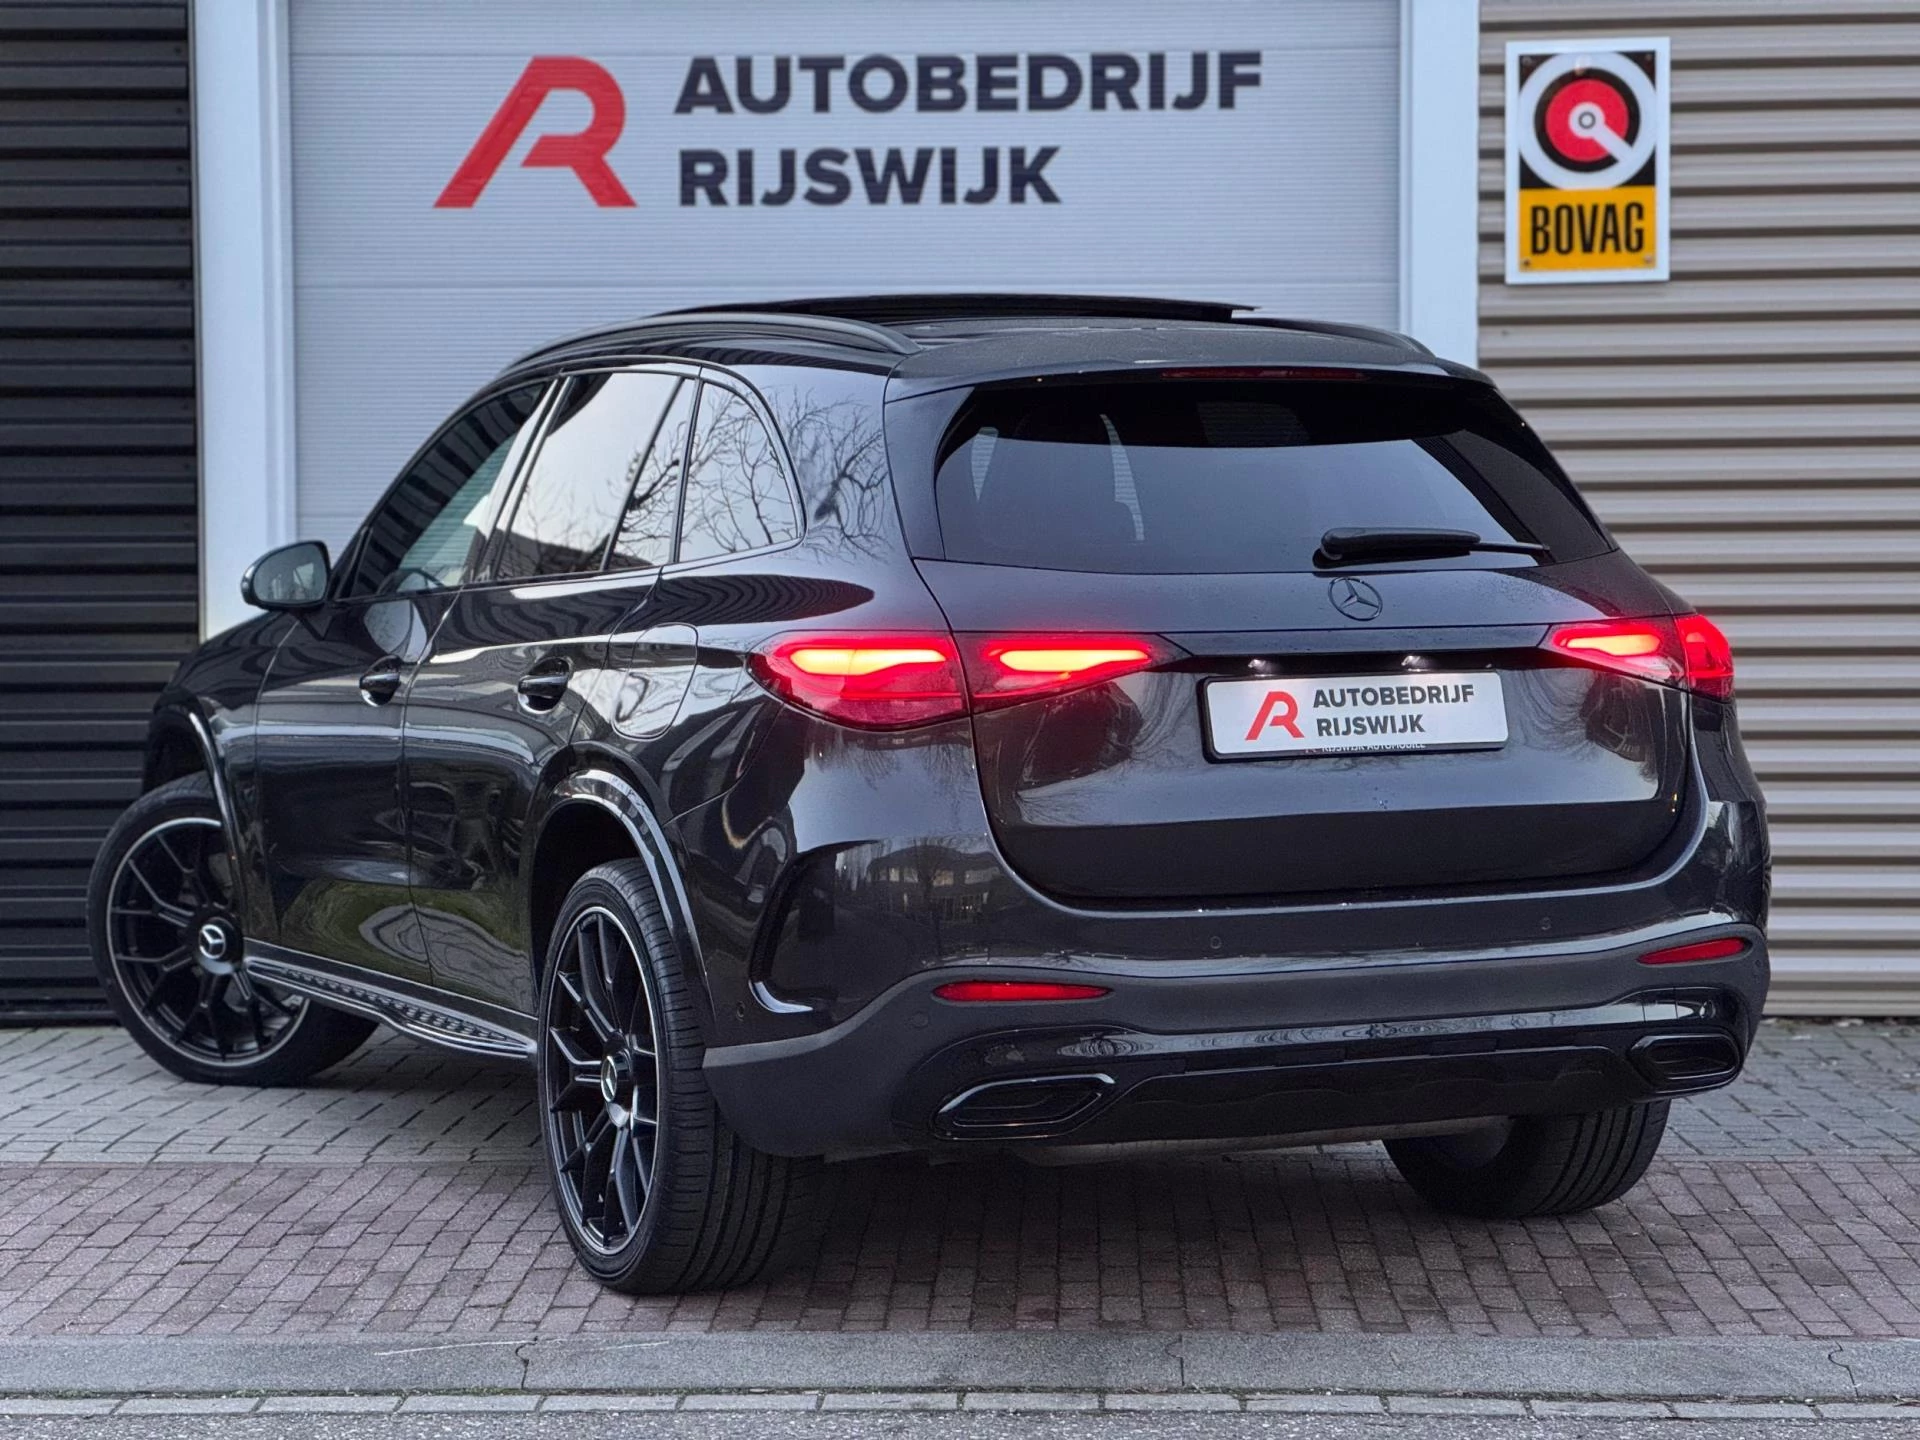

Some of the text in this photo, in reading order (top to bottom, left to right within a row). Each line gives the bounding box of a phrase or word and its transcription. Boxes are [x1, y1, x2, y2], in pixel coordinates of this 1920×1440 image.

[674, 50, 1262, 115] AUTOBEDRIJF
[679, 146, 1061, 207] RIJSWIJK
[1531, 202, 1644, 255] BOVAG
[1312, 684, 1475, 708] AUTOBEDRIJF
[1316, 714, 1426, 737] RIJSWIJK
